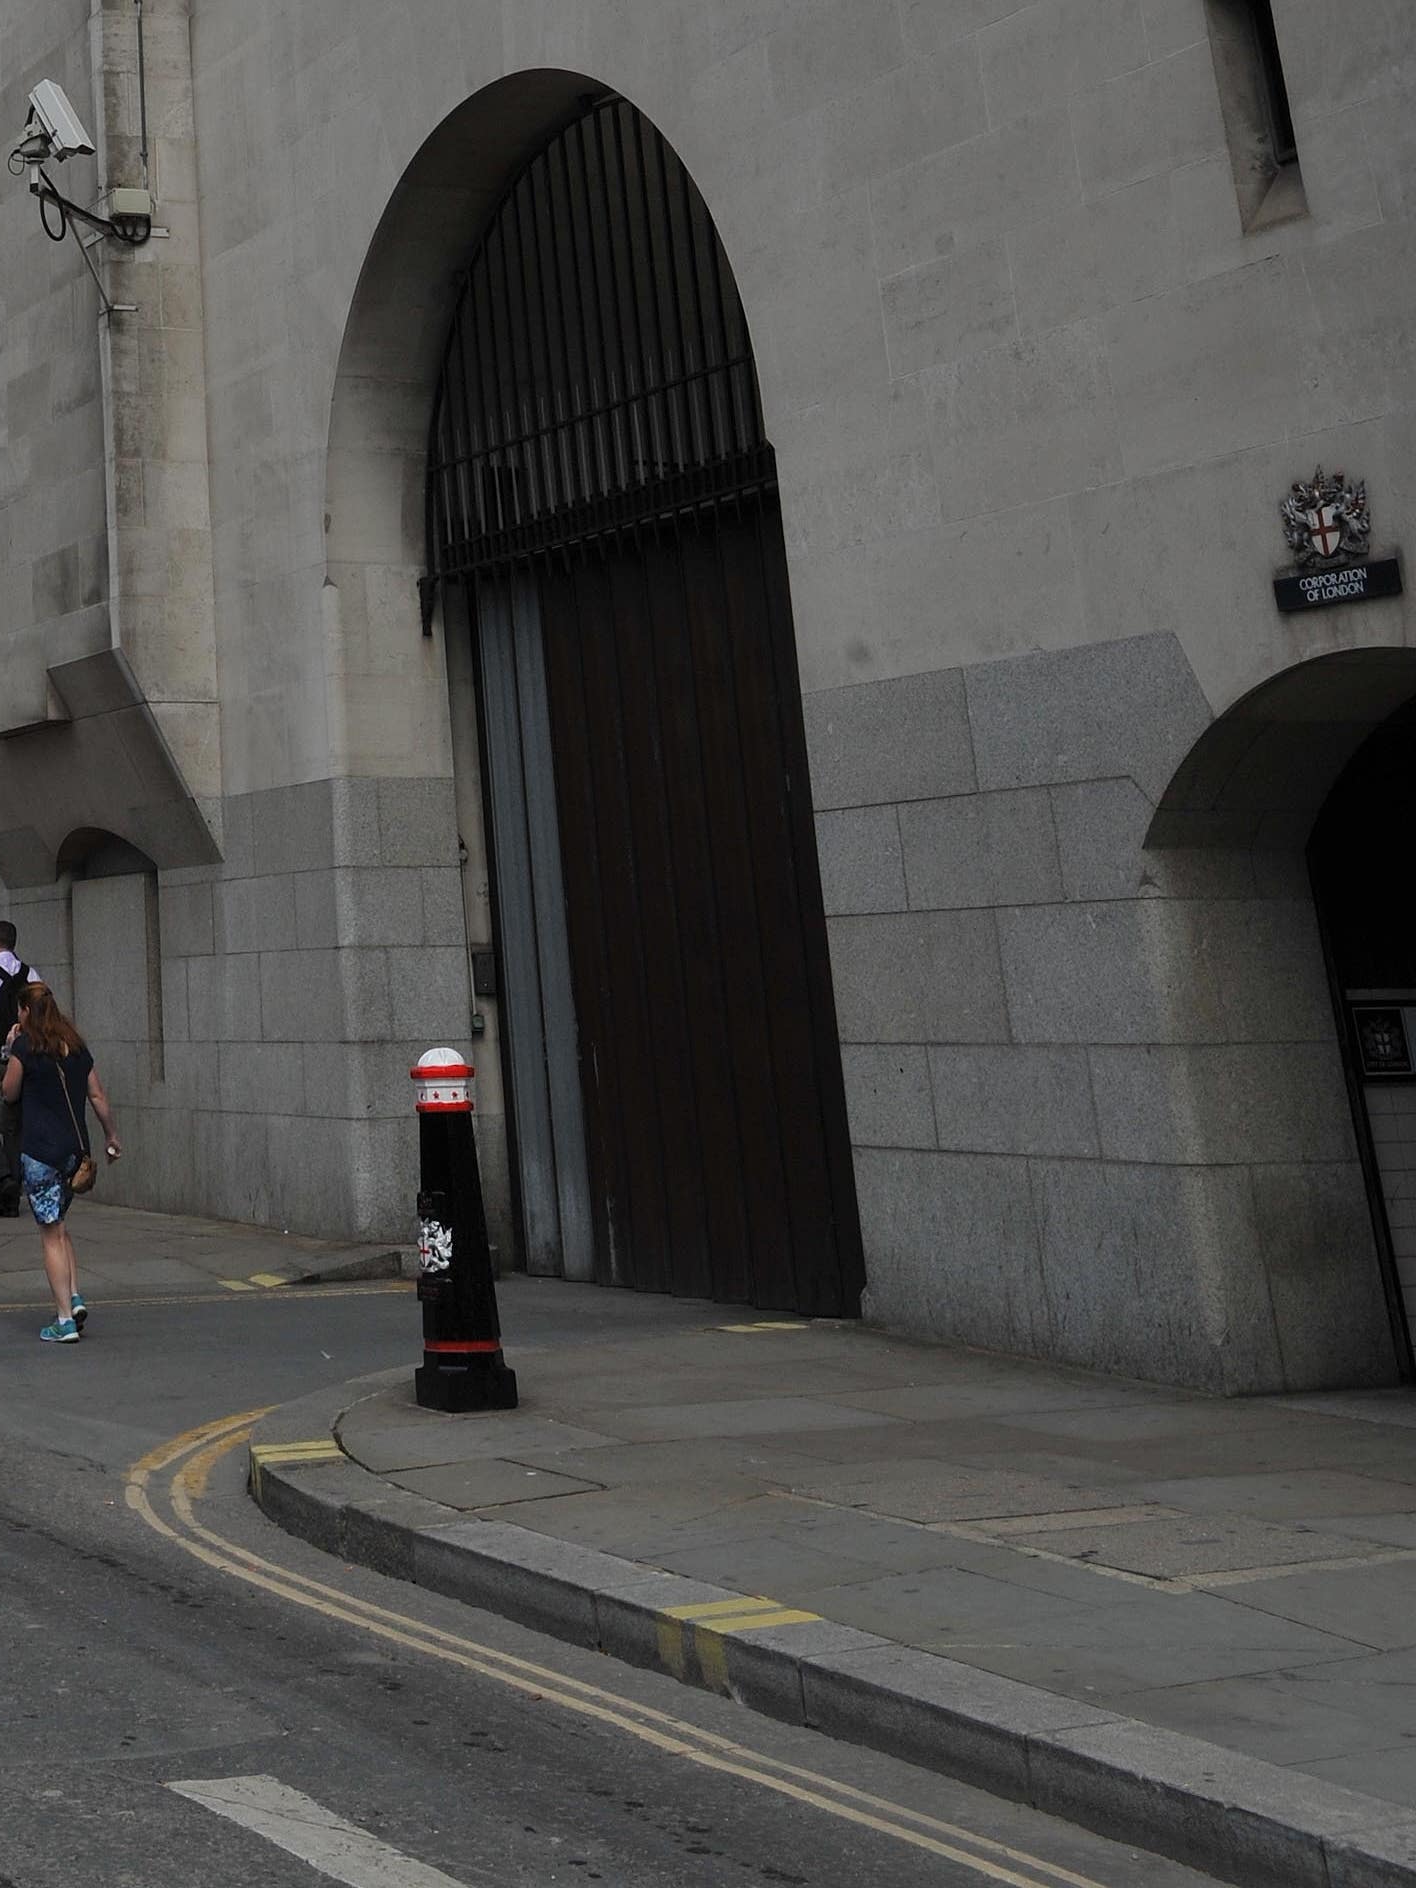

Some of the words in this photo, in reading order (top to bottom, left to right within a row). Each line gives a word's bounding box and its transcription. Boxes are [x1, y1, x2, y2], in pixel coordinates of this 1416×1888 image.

[1299, 568, 1367, 591] CORPORATION
[1306, 589, 1320, 602] OF
[1321, 581, 1364, 600] LONDON
